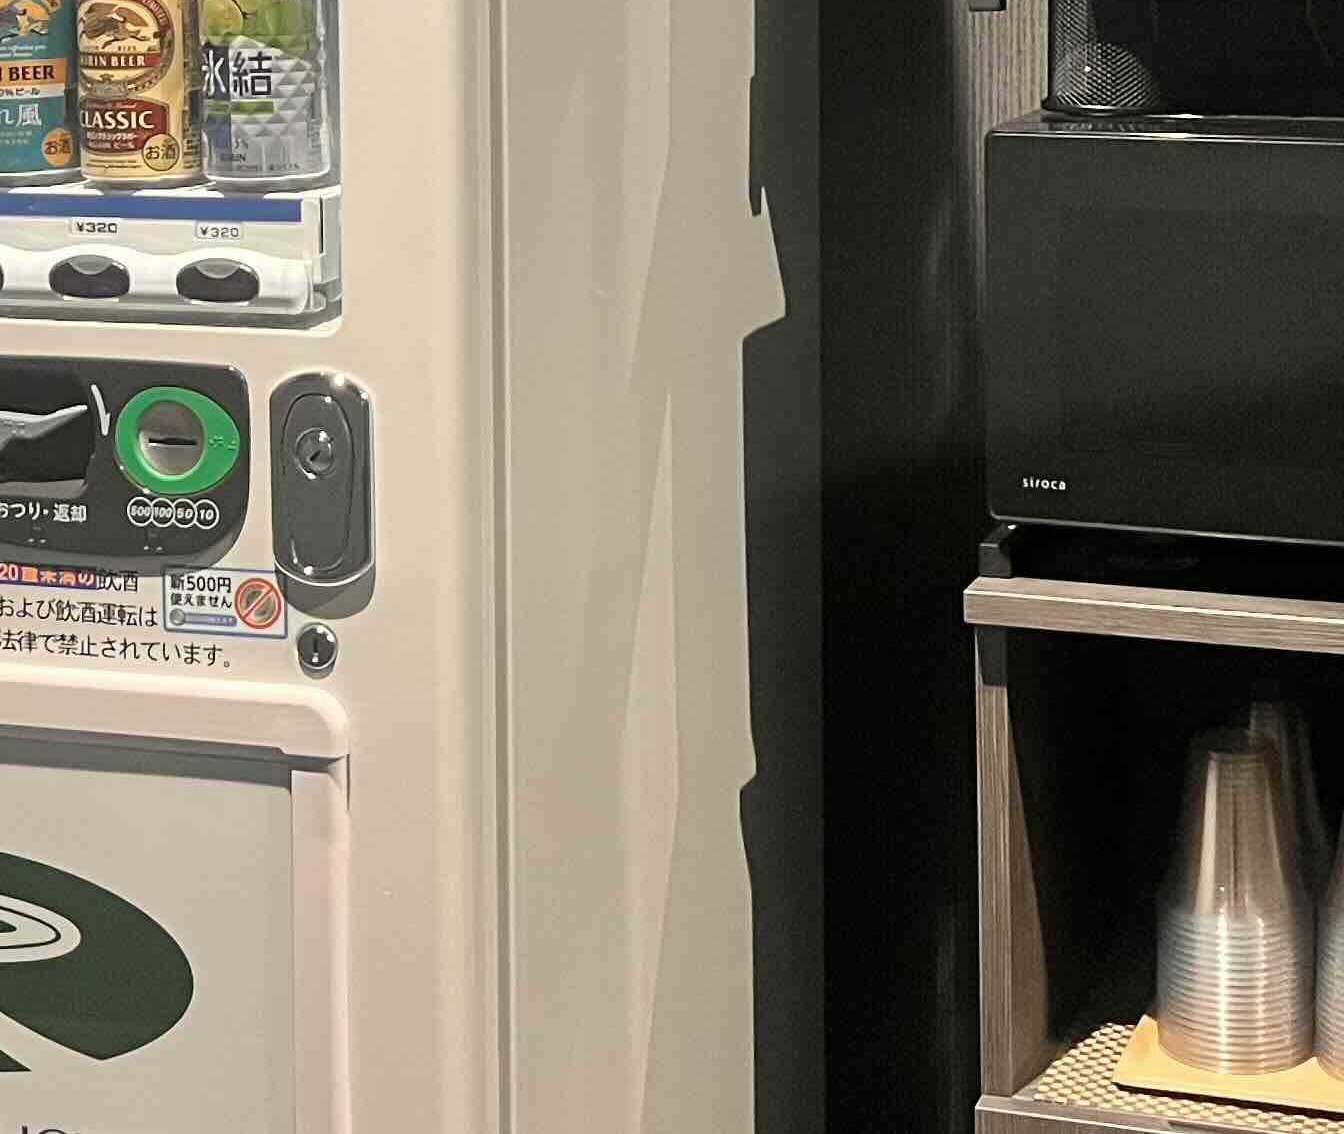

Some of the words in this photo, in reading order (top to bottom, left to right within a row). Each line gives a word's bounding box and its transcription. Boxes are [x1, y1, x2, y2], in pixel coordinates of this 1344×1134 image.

[110, 55, 146, 67] BEER
[8, 65, 55, 81] BEER
[201, 49, 273, 97] 氷結
[80, 110, 155, 130] CLASSIC
[44, 138, 72, 155] お酒
[145, 143, 176, 160] お酒
[76, 221, 118, 234] ¥320
[200, 225, 240, 238] ¥320
[1022, 476, 1066, 491] siroca
[131, 506, 151, 517] 500
[176, 507, 193, 519] 50
[199, 508, 214, 521] 10
[170, 574, 232, 593] 新500円
[170, 592, 233, 609] 使えません
